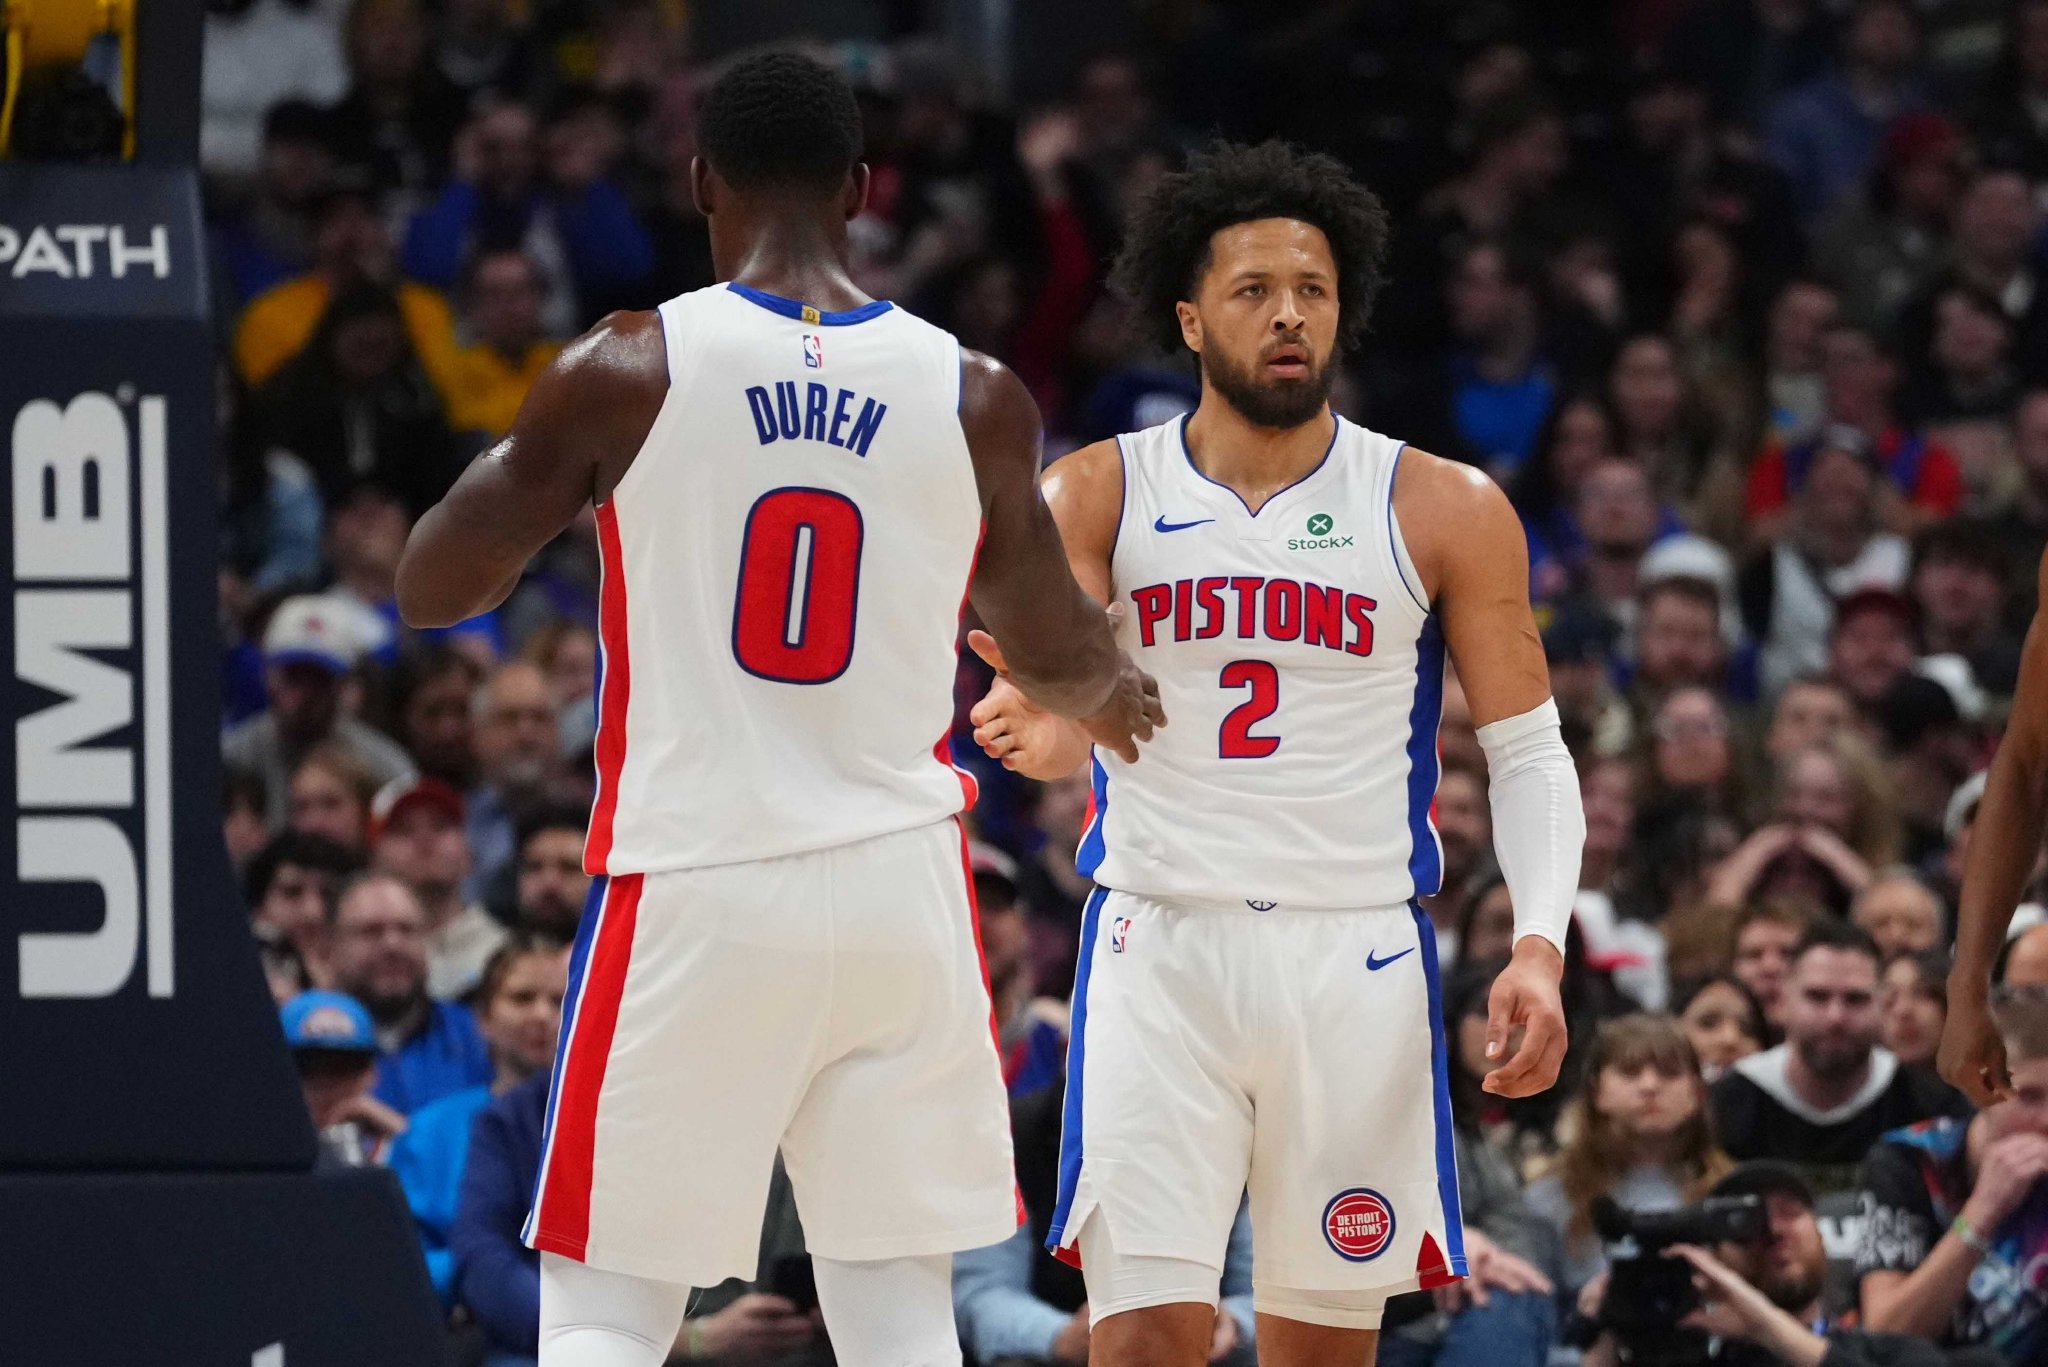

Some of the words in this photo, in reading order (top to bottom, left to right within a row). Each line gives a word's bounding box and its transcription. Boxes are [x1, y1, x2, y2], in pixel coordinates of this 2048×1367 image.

[745, 380, 887, 458] DUREN
[1288, 536, 1353, 550] StockX
[731, 486, 864, 685] 0
[1131, 576, 1377, 657] PISTONS
[12, 391, 140, 998] UMB
[1219, 659, 1281, 758] 2
[1336, 1211, 1380, 1226] DETROIT
[1337, 1223, 1381, 1238] PISTONS
